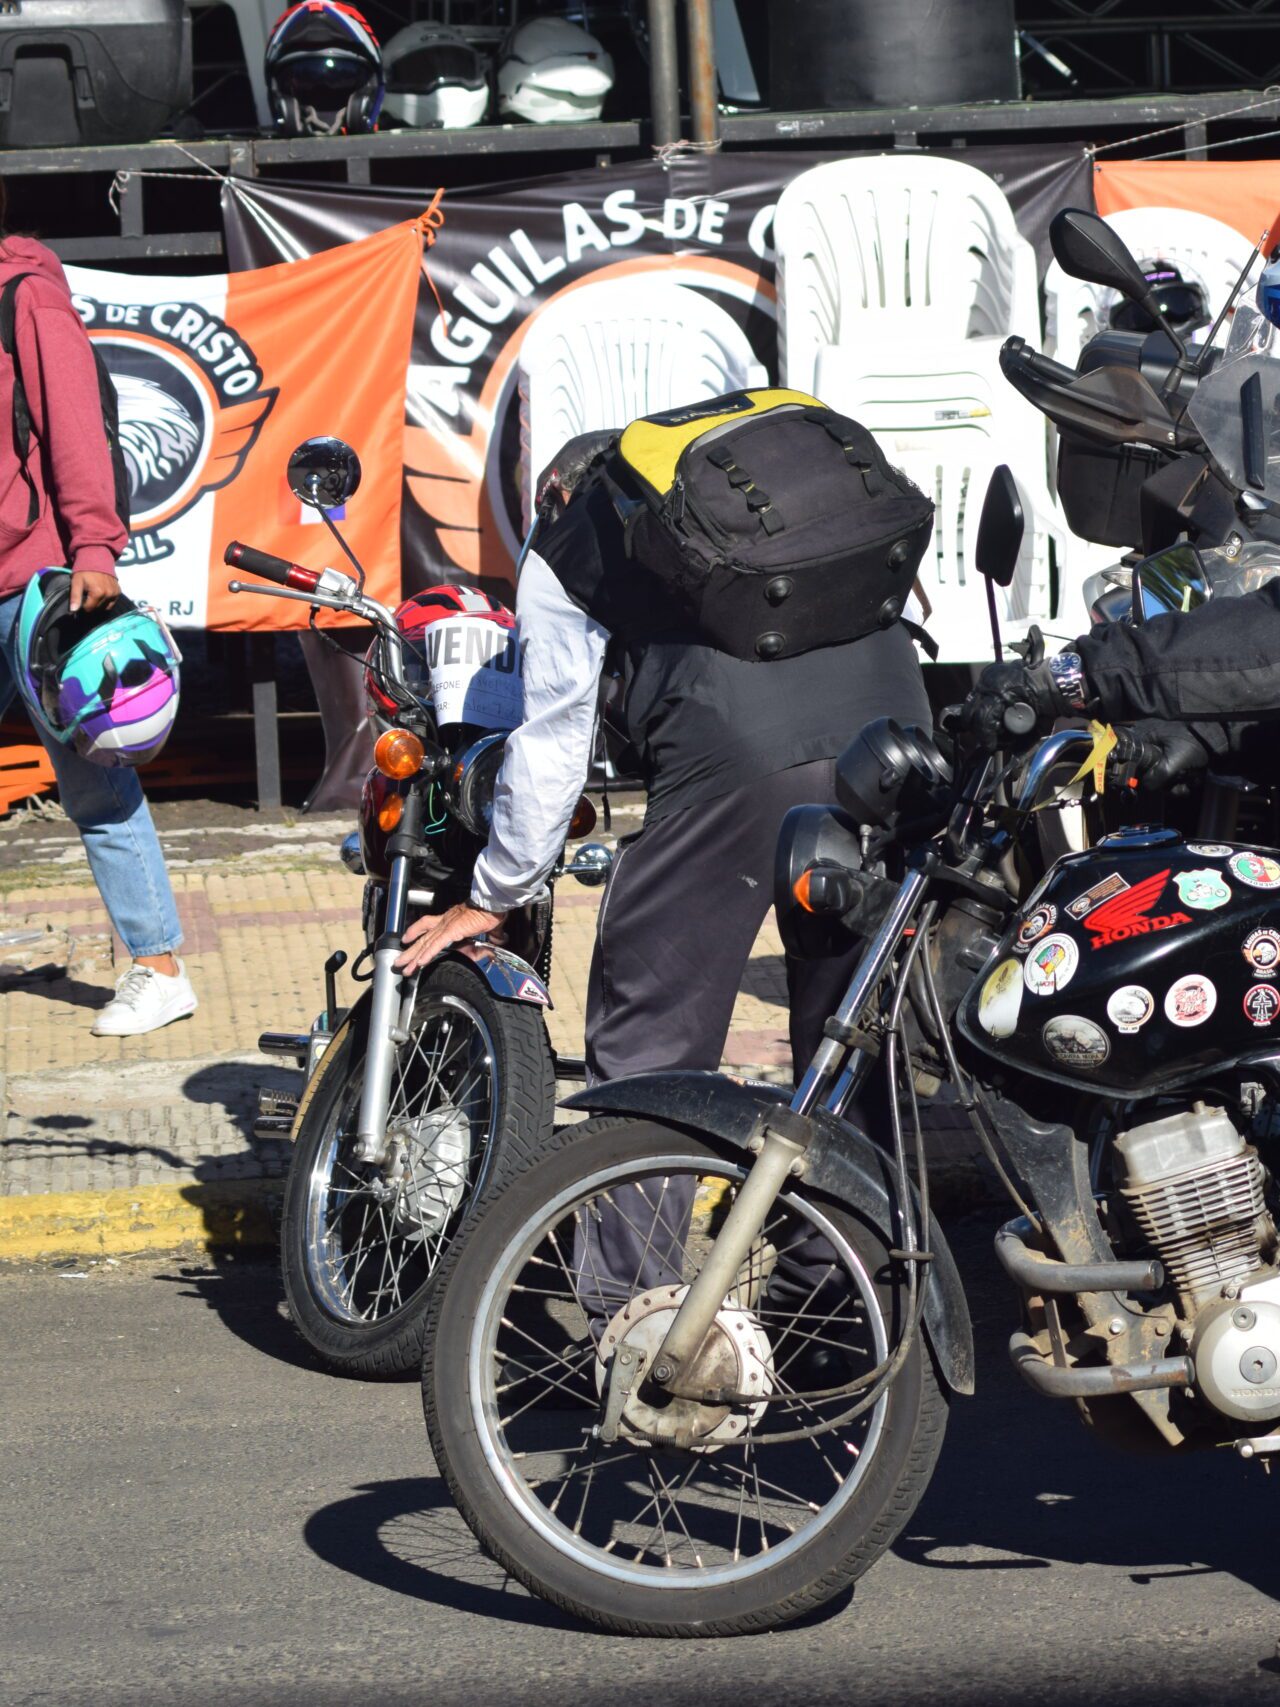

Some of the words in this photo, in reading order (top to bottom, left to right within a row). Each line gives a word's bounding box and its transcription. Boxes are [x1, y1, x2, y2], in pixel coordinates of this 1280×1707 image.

[663, 198, 730, 244] DE
[106, 304, 142, 325] DE
[150, 303, 258, 396] CRISTO
[169, 600, 194, 617] RJ
[1090, 912, 1193, 951] HONDA
